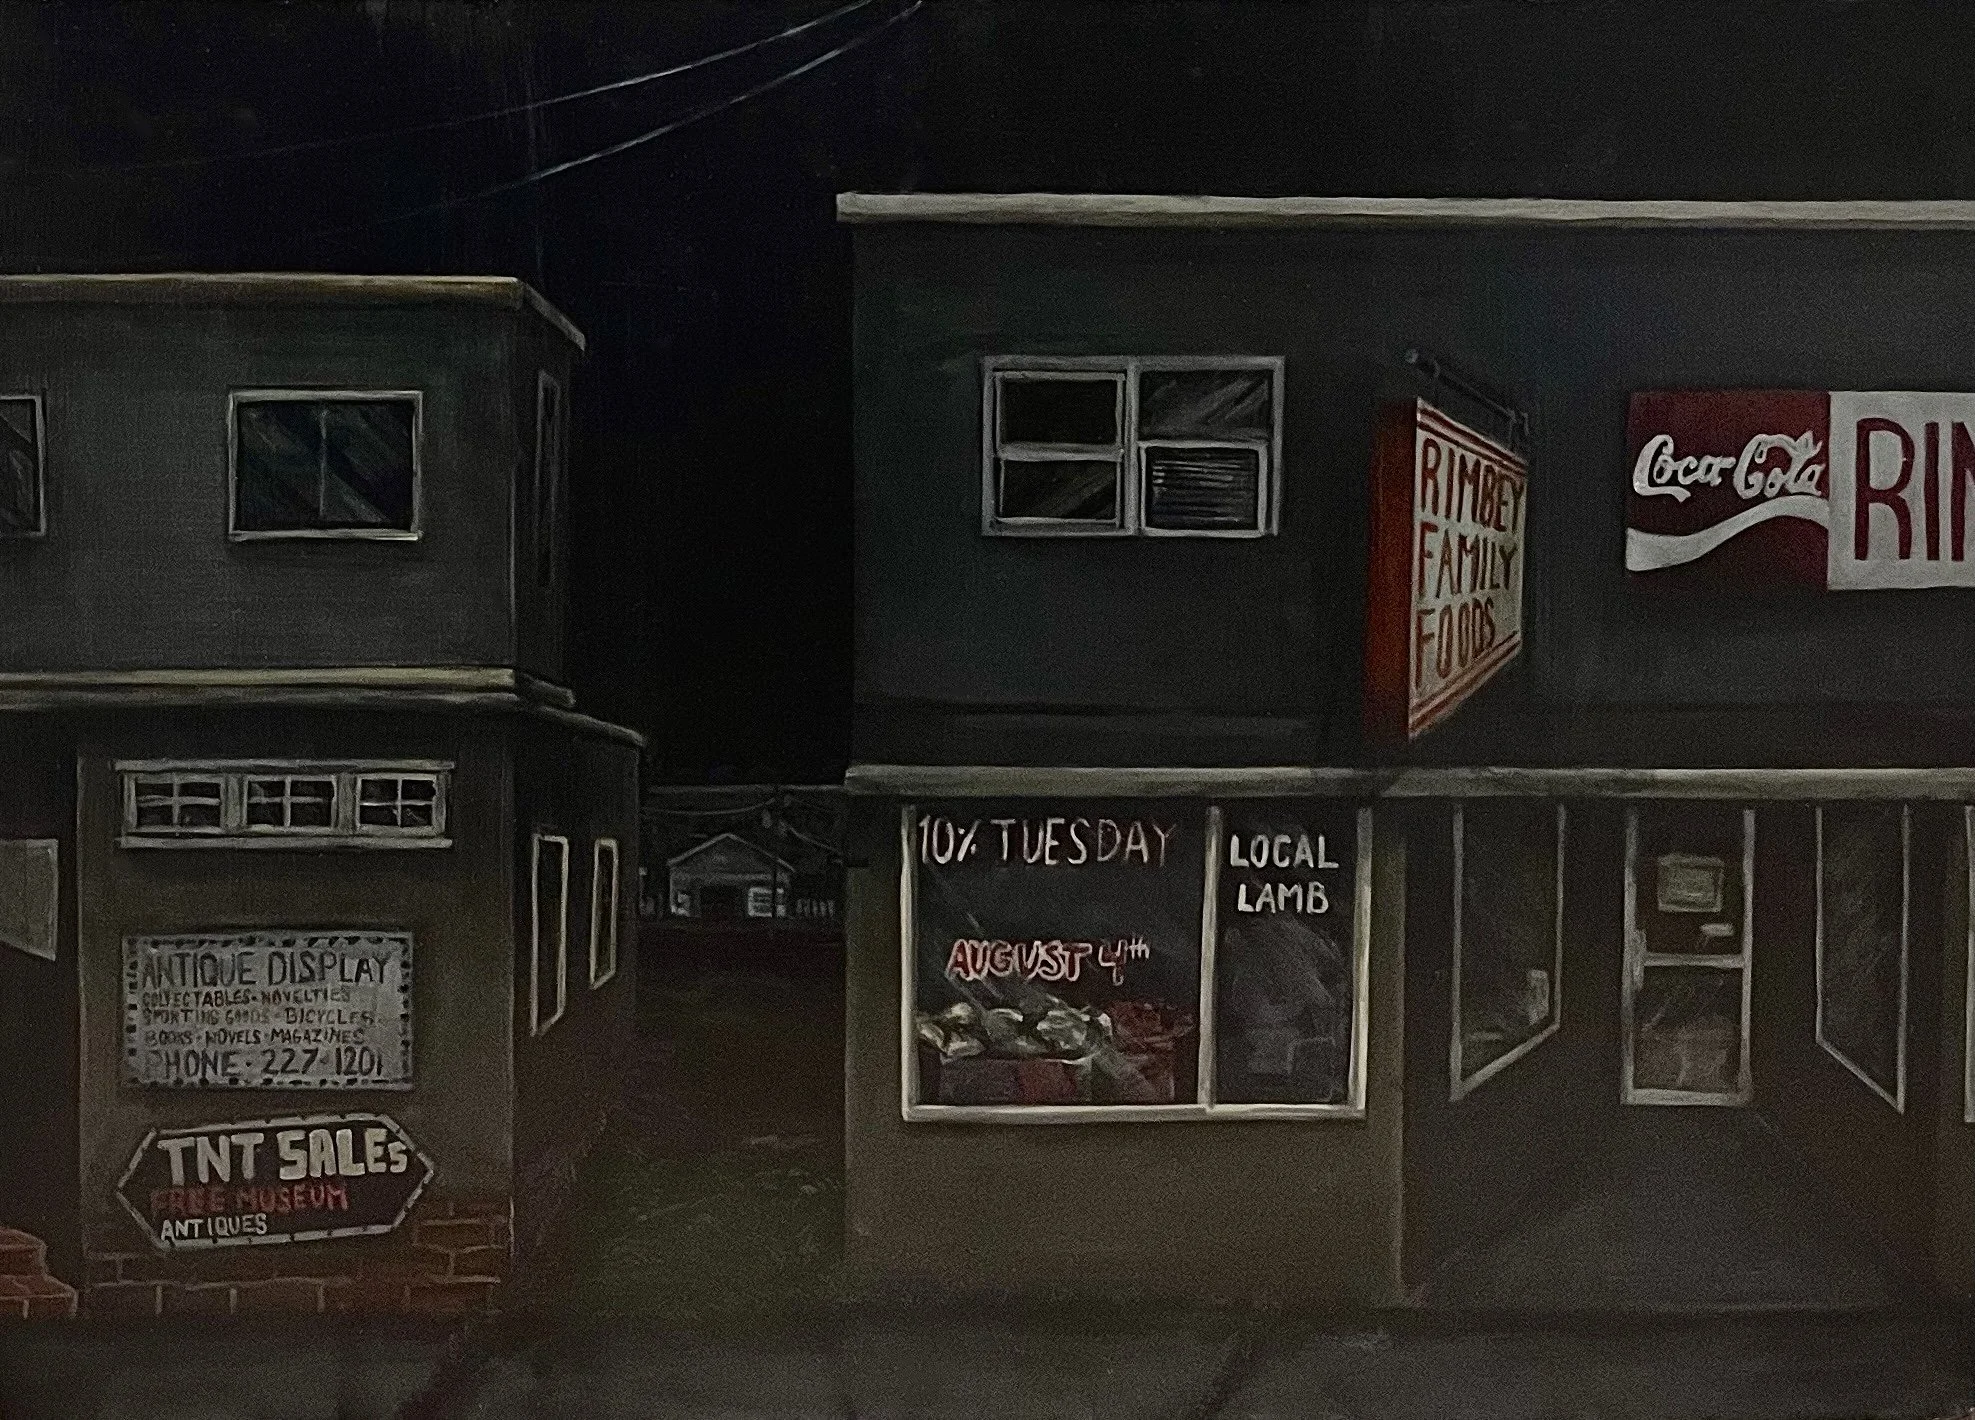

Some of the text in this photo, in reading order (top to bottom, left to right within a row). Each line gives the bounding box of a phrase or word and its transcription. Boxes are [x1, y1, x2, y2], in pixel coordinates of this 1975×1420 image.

[1421, 438, 1523, 533] RIMBEY
[1632, 429, 1827, 504] Coca-Cola
[1420, 522, 1519, 598] FAMILY
[1416, 597, 1496, 690] FOODS
[918, 814, 1179, 867] 10% TUESDAY
[1229, 832, 1340, 870] LOCAL
[1236, 880, 1331, 914] LAMB
[143, 949, 392, 988] ANTIQUE DISPLAY
[944, 938, 1093, 982] AUGUST
[284, 1008, 375, 1025] BICYCLES
[205, 1028, 260, 1046] NOVELS
[270, 1027, 366, 1046] MAGAZINES
[146, 1048, 240, 1078] PHONE
[156, 1127, 408, 1186] TNT SALES
[239, 1182, 349, 1213] MUSEUM
[160, 1212, 268, 1241] ANTIQUES
